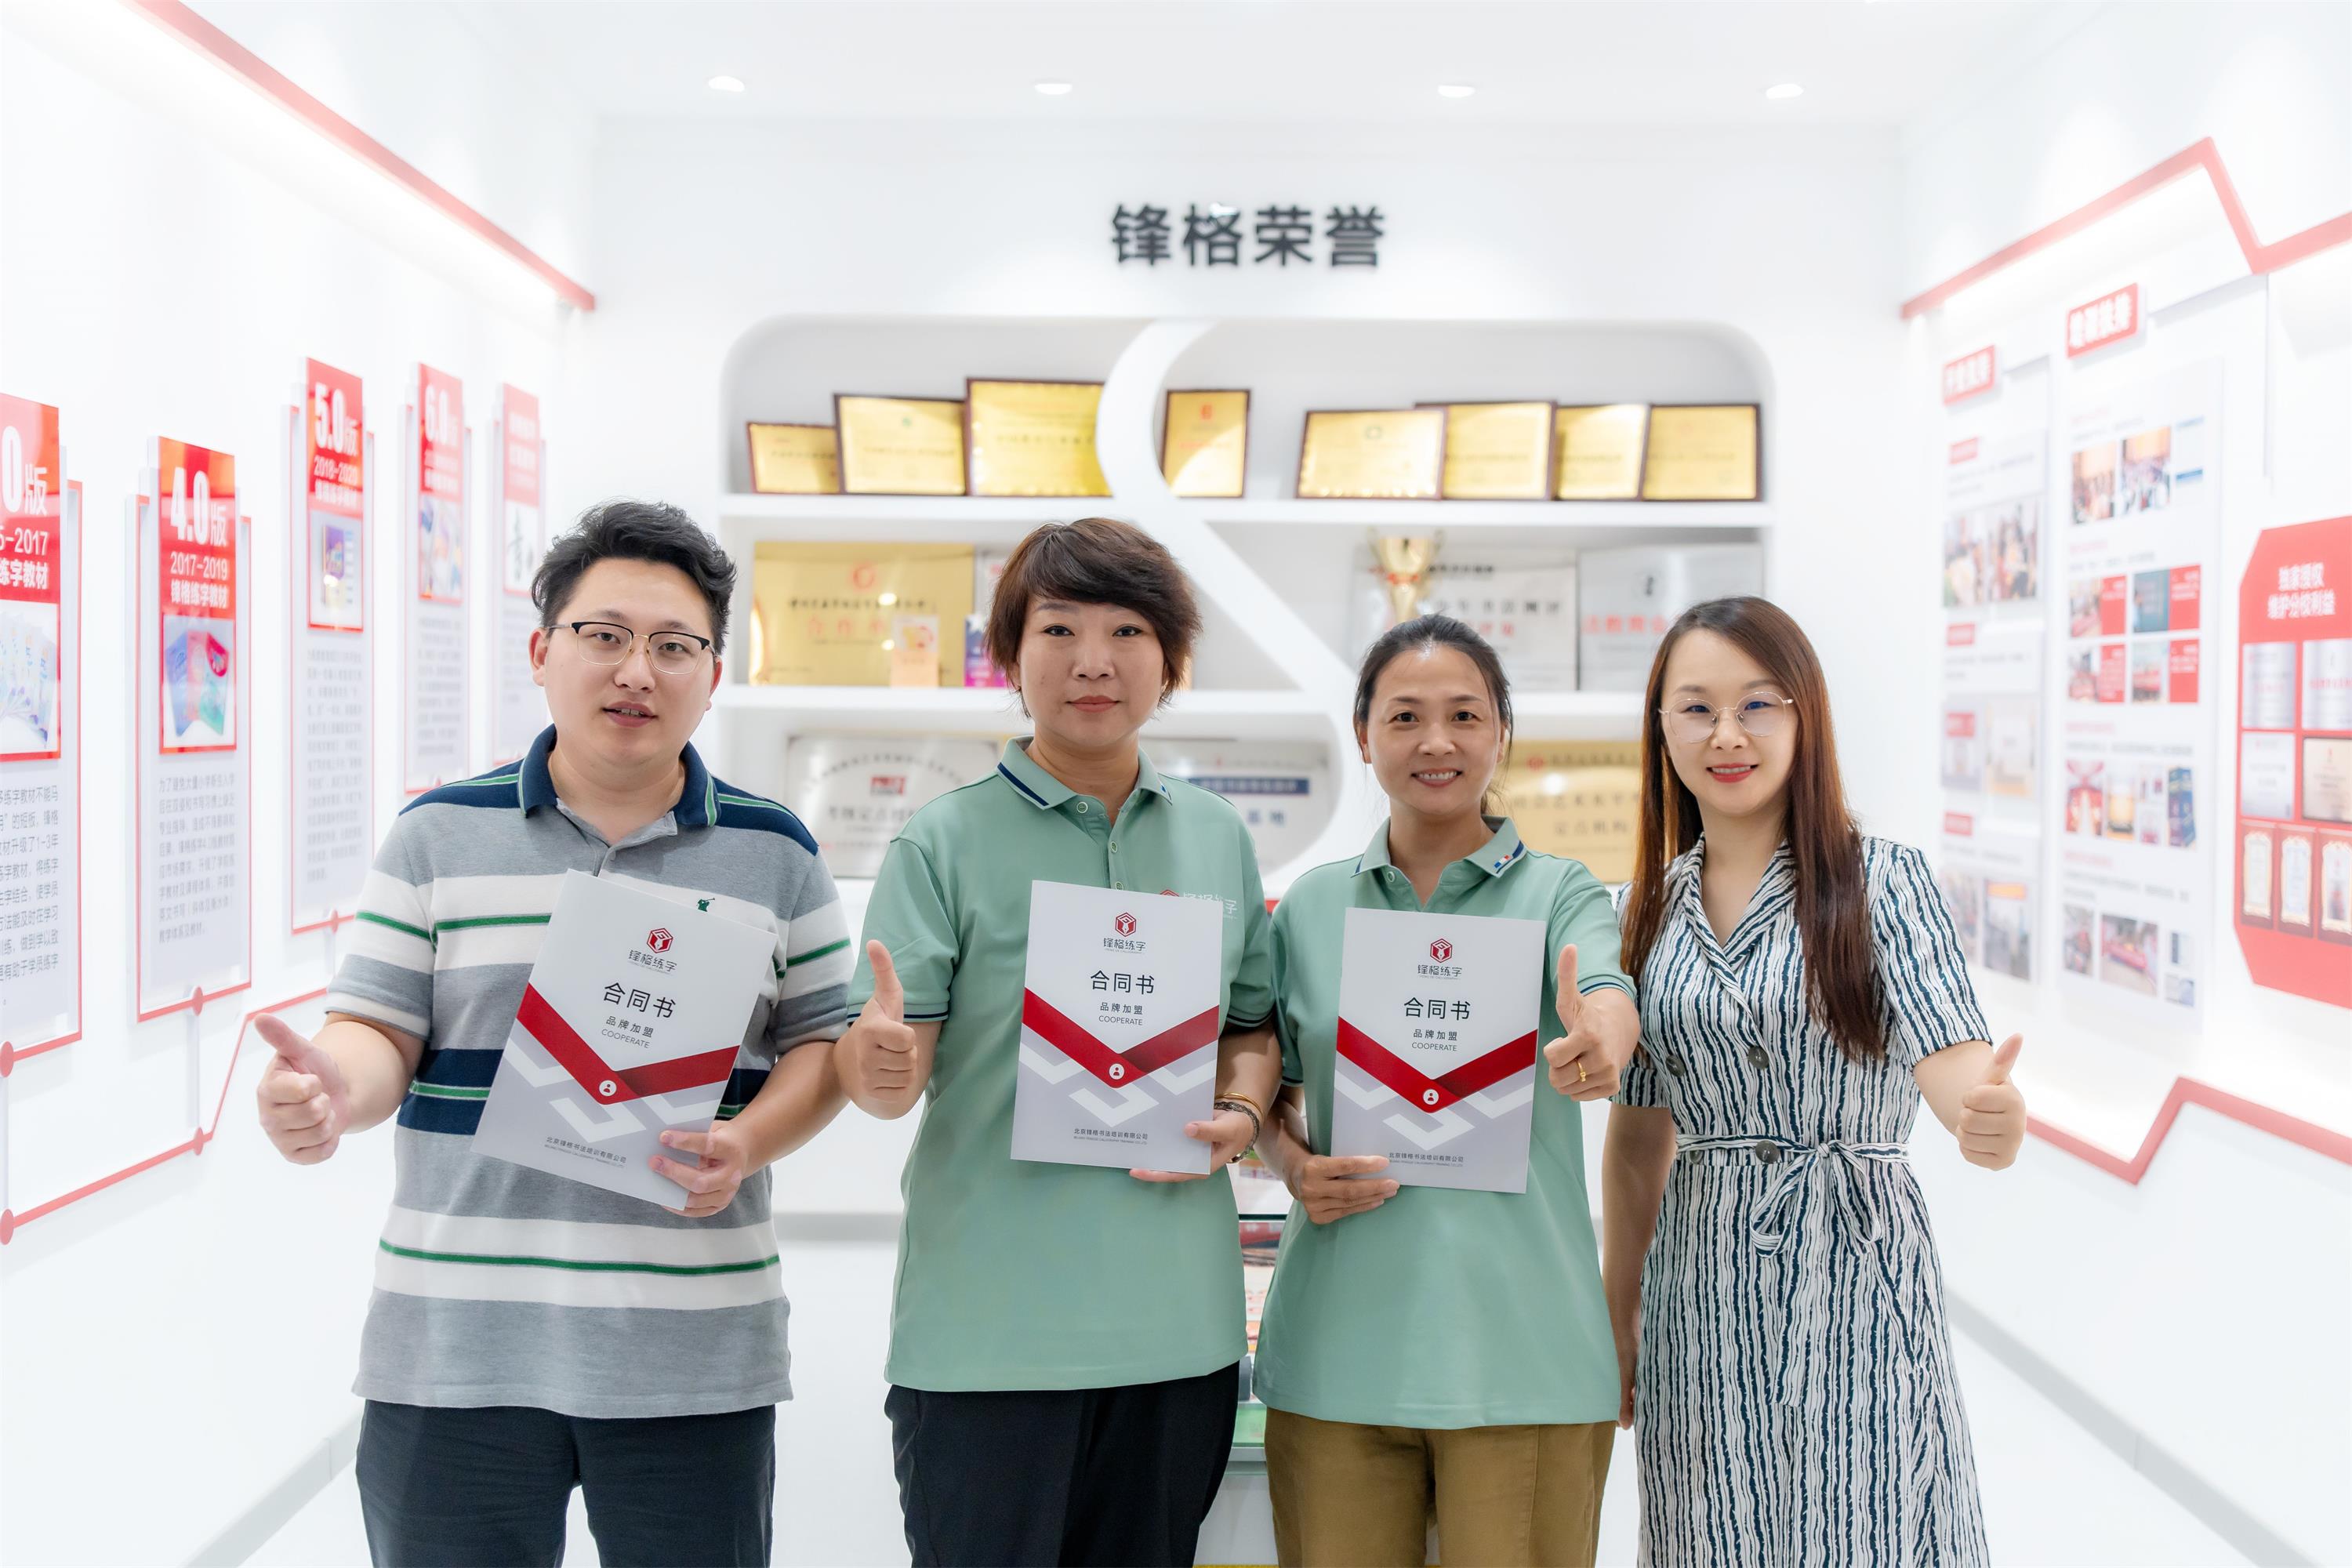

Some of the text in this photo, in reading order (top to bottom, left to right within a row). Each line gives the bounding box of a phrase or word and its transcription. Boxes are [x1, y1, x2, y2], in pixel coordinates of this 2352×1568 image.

[1112, 204, 1385, 267] 锋格荣誉
[170, 466, 227, 547] 4.0版
[170, 550, 228, 582] 2017-2019
[170, 579, 228, 610] 锋格练字教材
[1103, 937, 1146, 952] 锋格练字
[628, 949, 677, 972] 锋格练字
[1417, 964, 1462, 978] 锋格练字
[1091, 970, 1155, 995] 合同书
[603, 982, 677, 1019] 合同书
[1099, 1001, 1143, 1015] 品牌加盟
[1404, 996, 1471, 1021] 合同书
[605, 1015, 655, 1038] 品牌加盟
[1098, 1014, 1143, 1025] COOPERATE
[601, 1028, 651, 1049] COOPERATE
[1411, 1041, 1457, 1052] COOPERATE
[1413, 1029, 1457, 1041] 品牌加盟
[1073, 1127, 1149, 1141] 北京锋格书法培训有限公司
